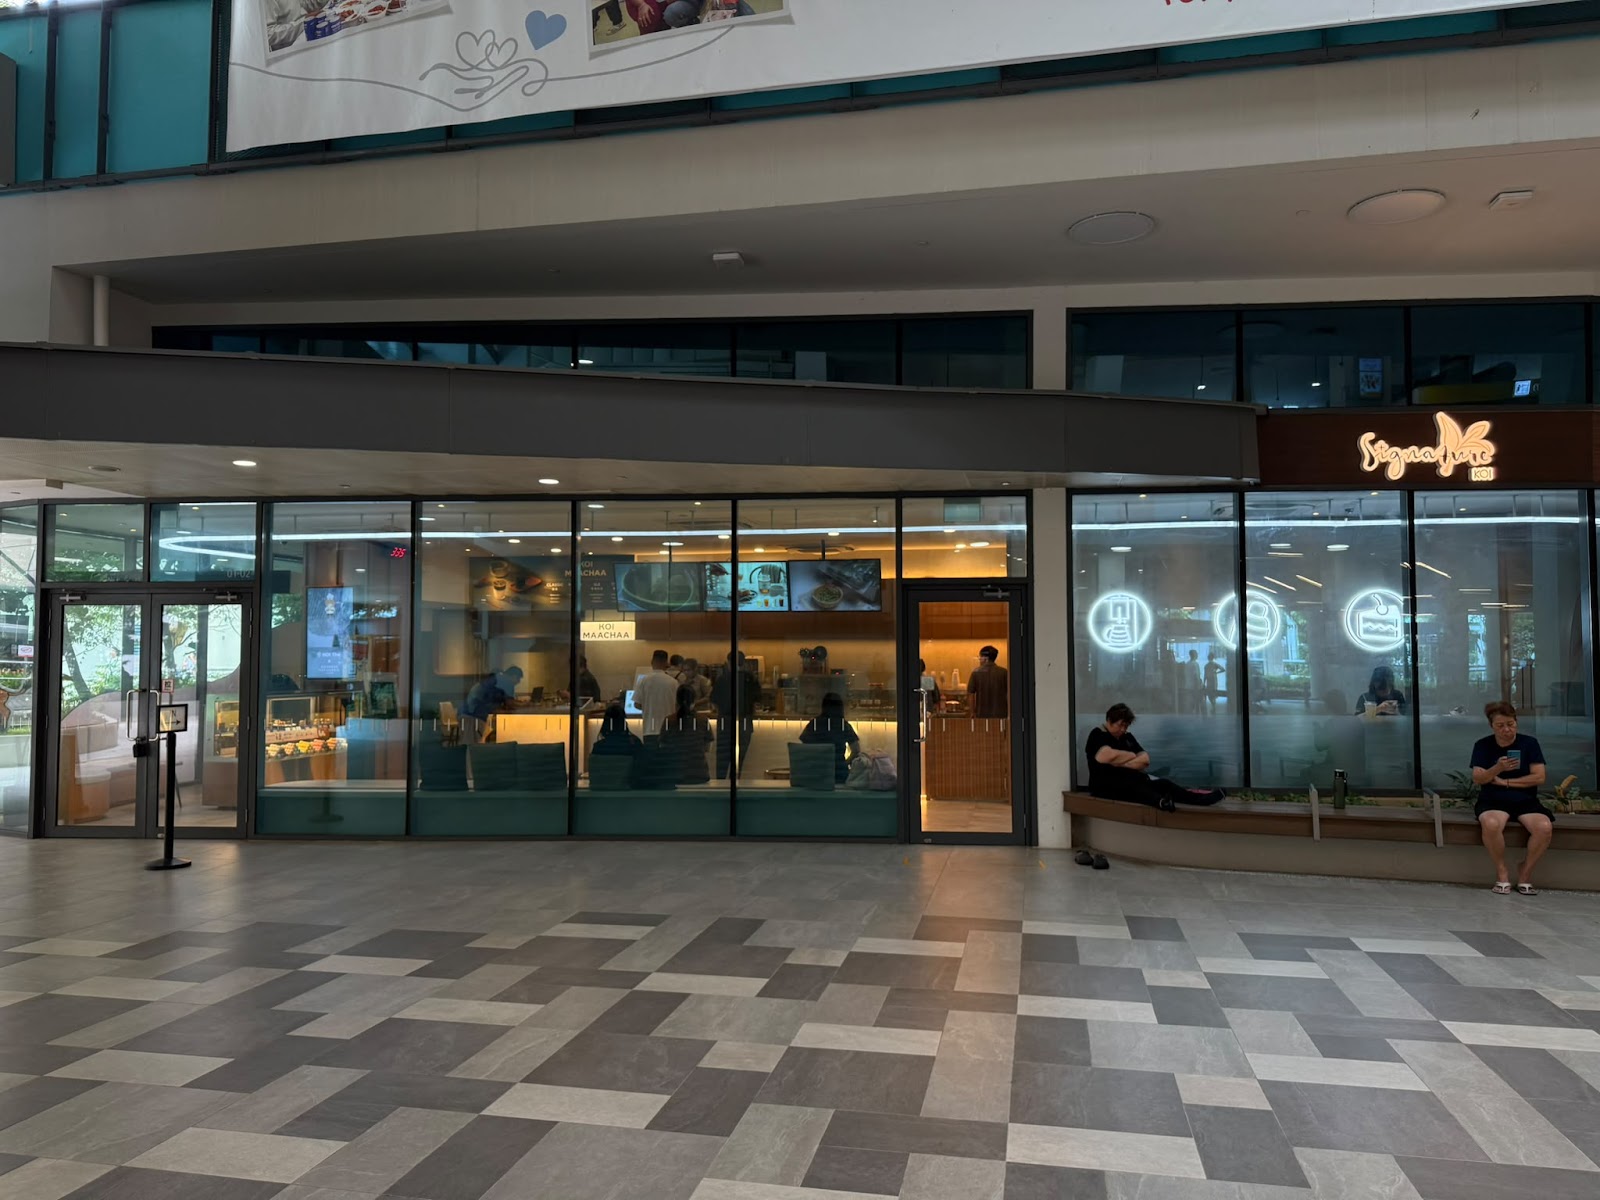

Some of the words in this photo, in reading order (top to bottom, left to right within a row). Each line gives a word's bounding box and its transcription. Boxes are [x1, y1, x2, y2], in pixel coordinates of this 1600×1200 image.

[1359, 420, 1493, 480] Signature
[1473, 469, 1493, 479] KOI
[598, 623, 615, 631] KOI
[582, 631, 630, 639] MAACHAA
